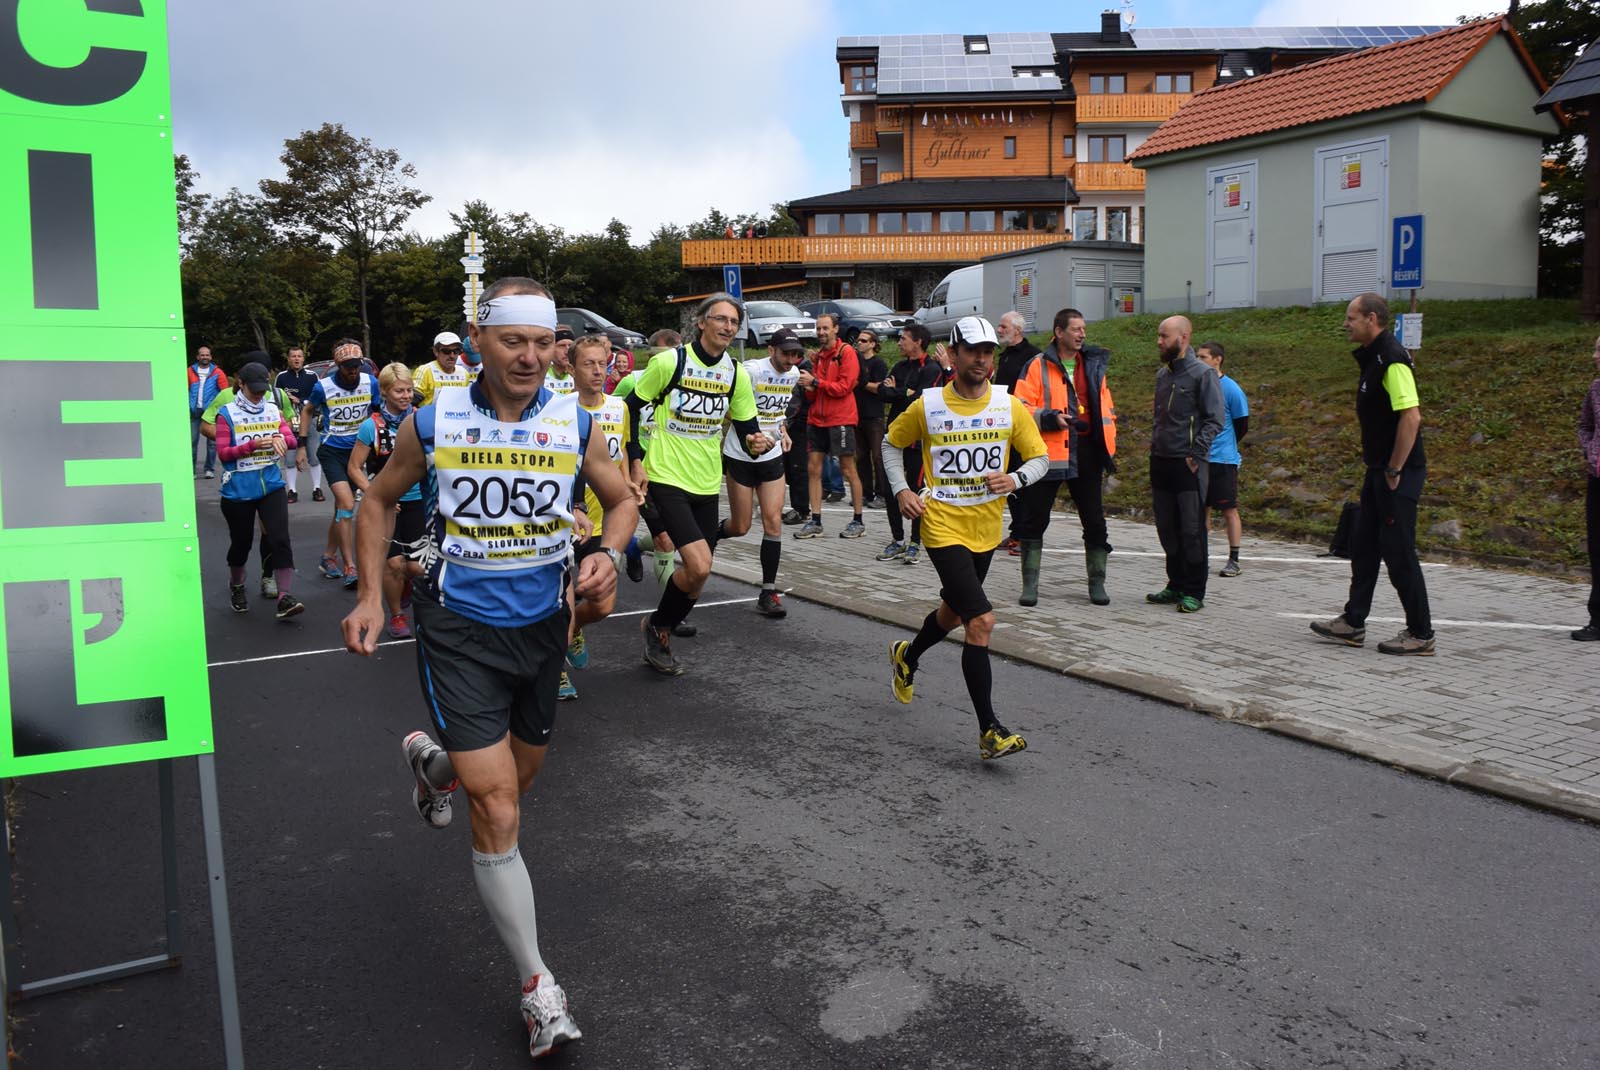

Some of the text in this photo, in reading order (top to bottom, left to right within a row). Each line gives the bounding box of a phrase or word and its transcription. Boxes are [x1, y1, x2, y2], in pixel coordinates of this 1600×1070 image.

[1400, 224, 1414, 264] P
[333, 404, 368, 420] 2057
[677, 391, 724, 416] 2204
[943, 431, 999, 443] BIELA STOPA
[461, 452, 555, 468] BIELA STOPA
[939, 446, 1002, 474] 2008
[452, 476, 561, 519] 2052
[488, 538, 537, 549] SLOVAKIA
